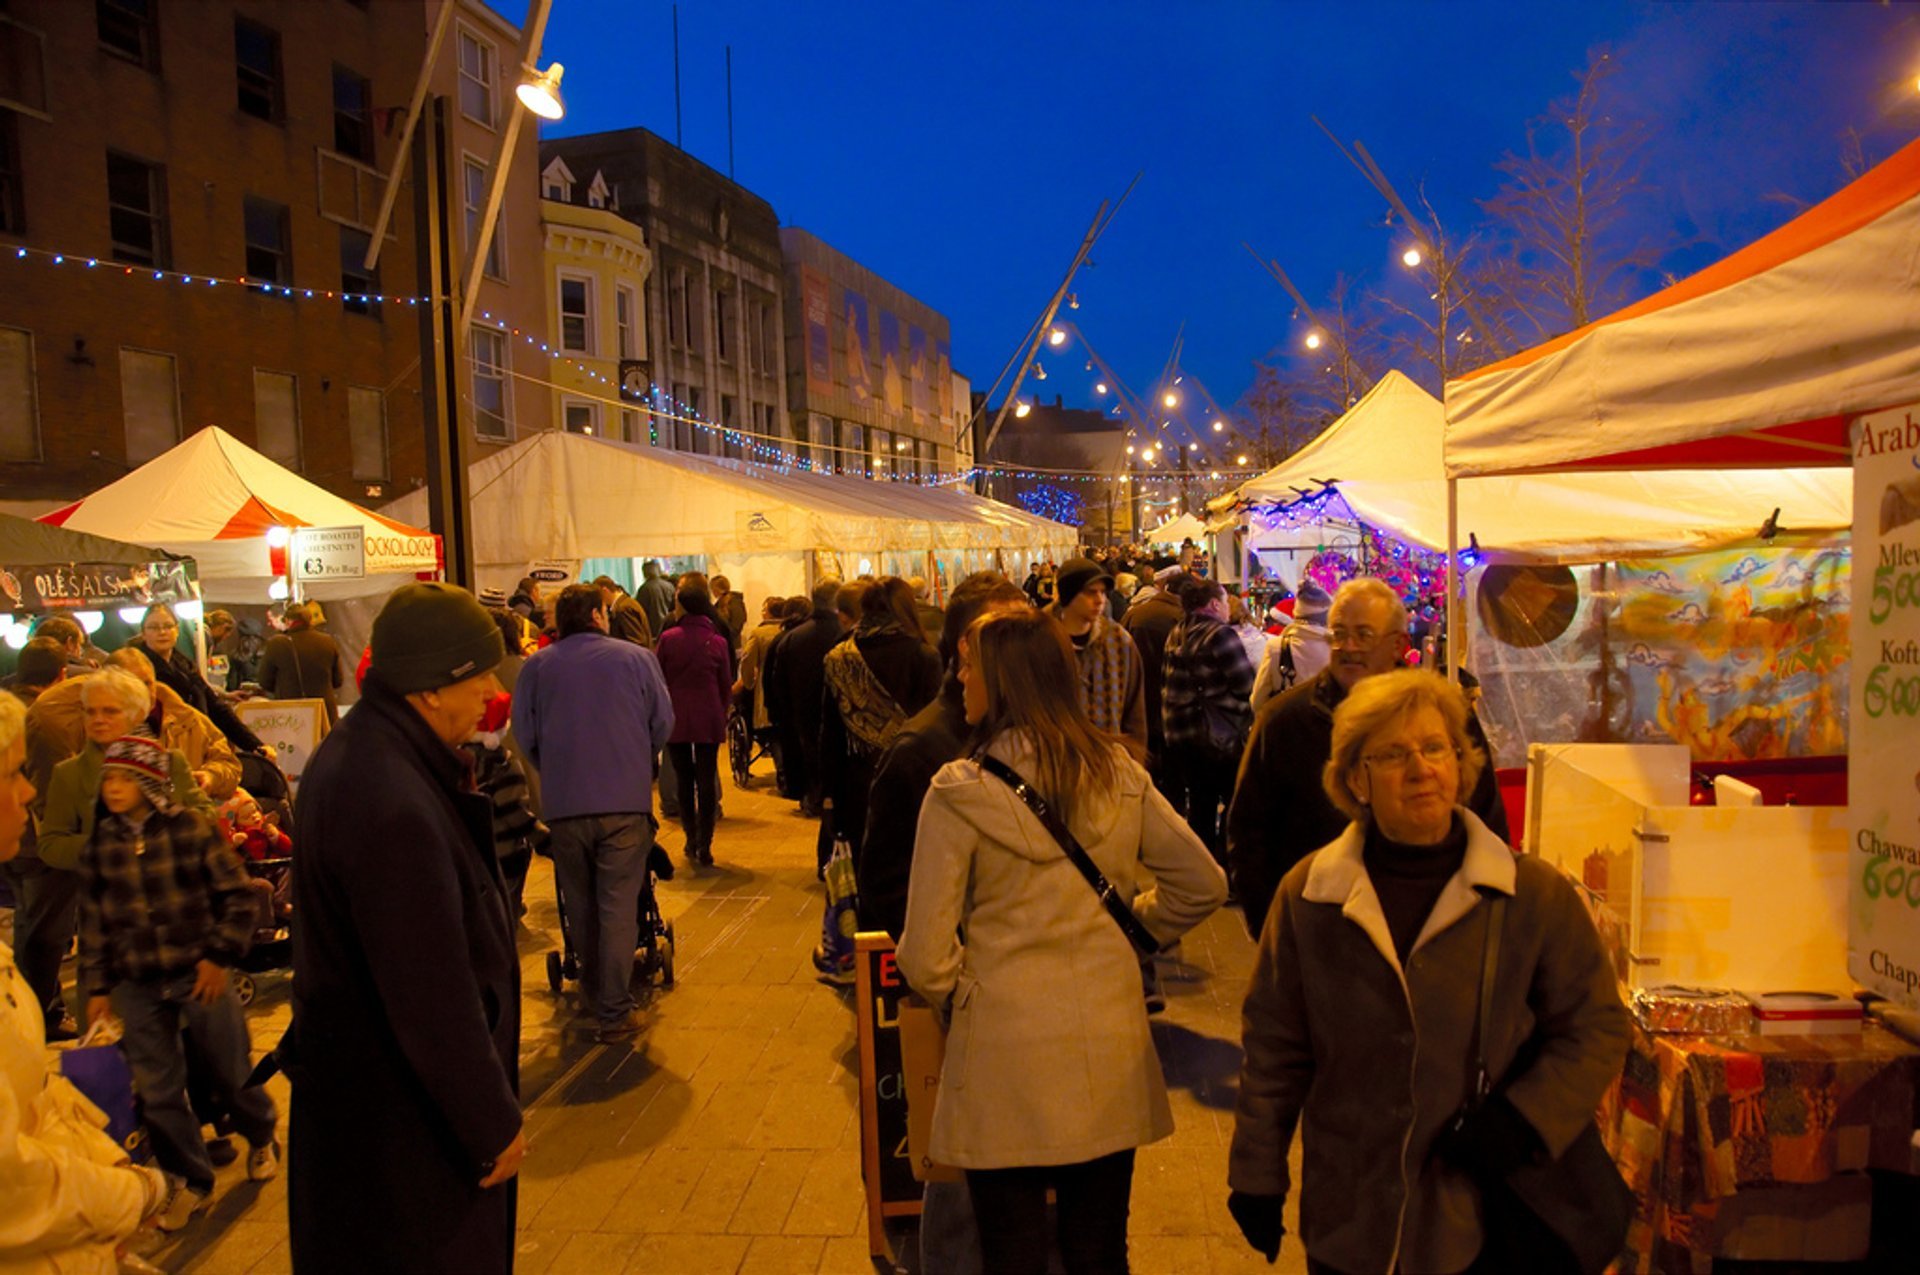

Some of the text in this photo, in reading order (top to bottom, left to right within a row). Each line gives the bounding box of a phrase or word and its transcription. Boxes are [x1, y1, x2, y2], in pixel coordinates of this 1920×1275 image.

[304, 557, 324, 575] €3
[342, 565, 360, 575] Bag
[69, 574, 131, 597] SALSA
[1869, 949, 1920, 993] Chap
